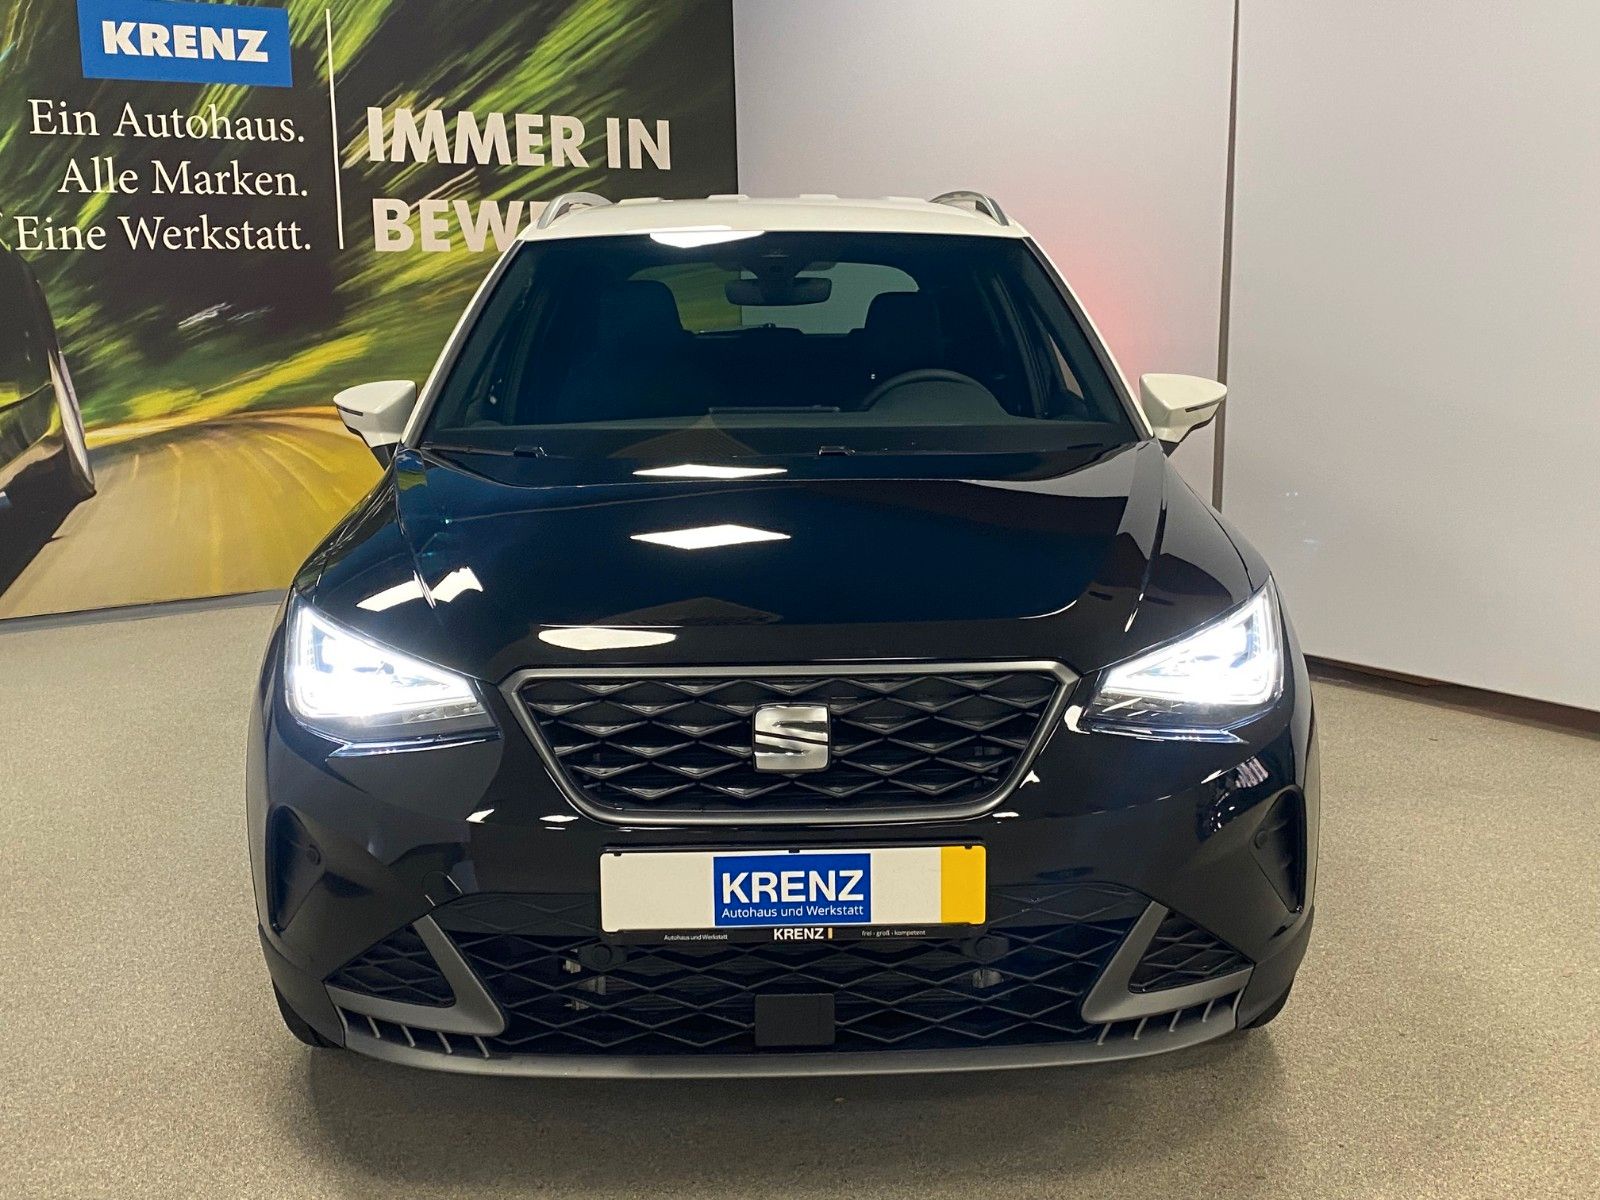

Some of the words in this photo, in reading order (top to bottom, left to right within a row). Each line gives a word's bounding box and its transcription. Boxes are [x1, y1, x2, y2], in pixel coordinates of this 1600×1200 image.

[102, 20, 269, 63] KRENZ
[28, 99, 100, 136] Ein
[113, 102, 305, 142] Autohaus.
[367, 107, 590, 168] IMMER
[606, 117, 671, 170] IN
[58, 156, 139, 194] Alle
[151, 159, 308, 197] Marken.
[14, 215, 106, 251] Eine
[118, 214, 311, 250] Werkstatt.
[722, 870, 864, 904] KRENZ
[721, 907, 777, 918] Autohaus
[780, 906, 803, 917] und
[806, 905, 864, 917] Werkstatt
[773, 927, 824, 941] KRENZ
